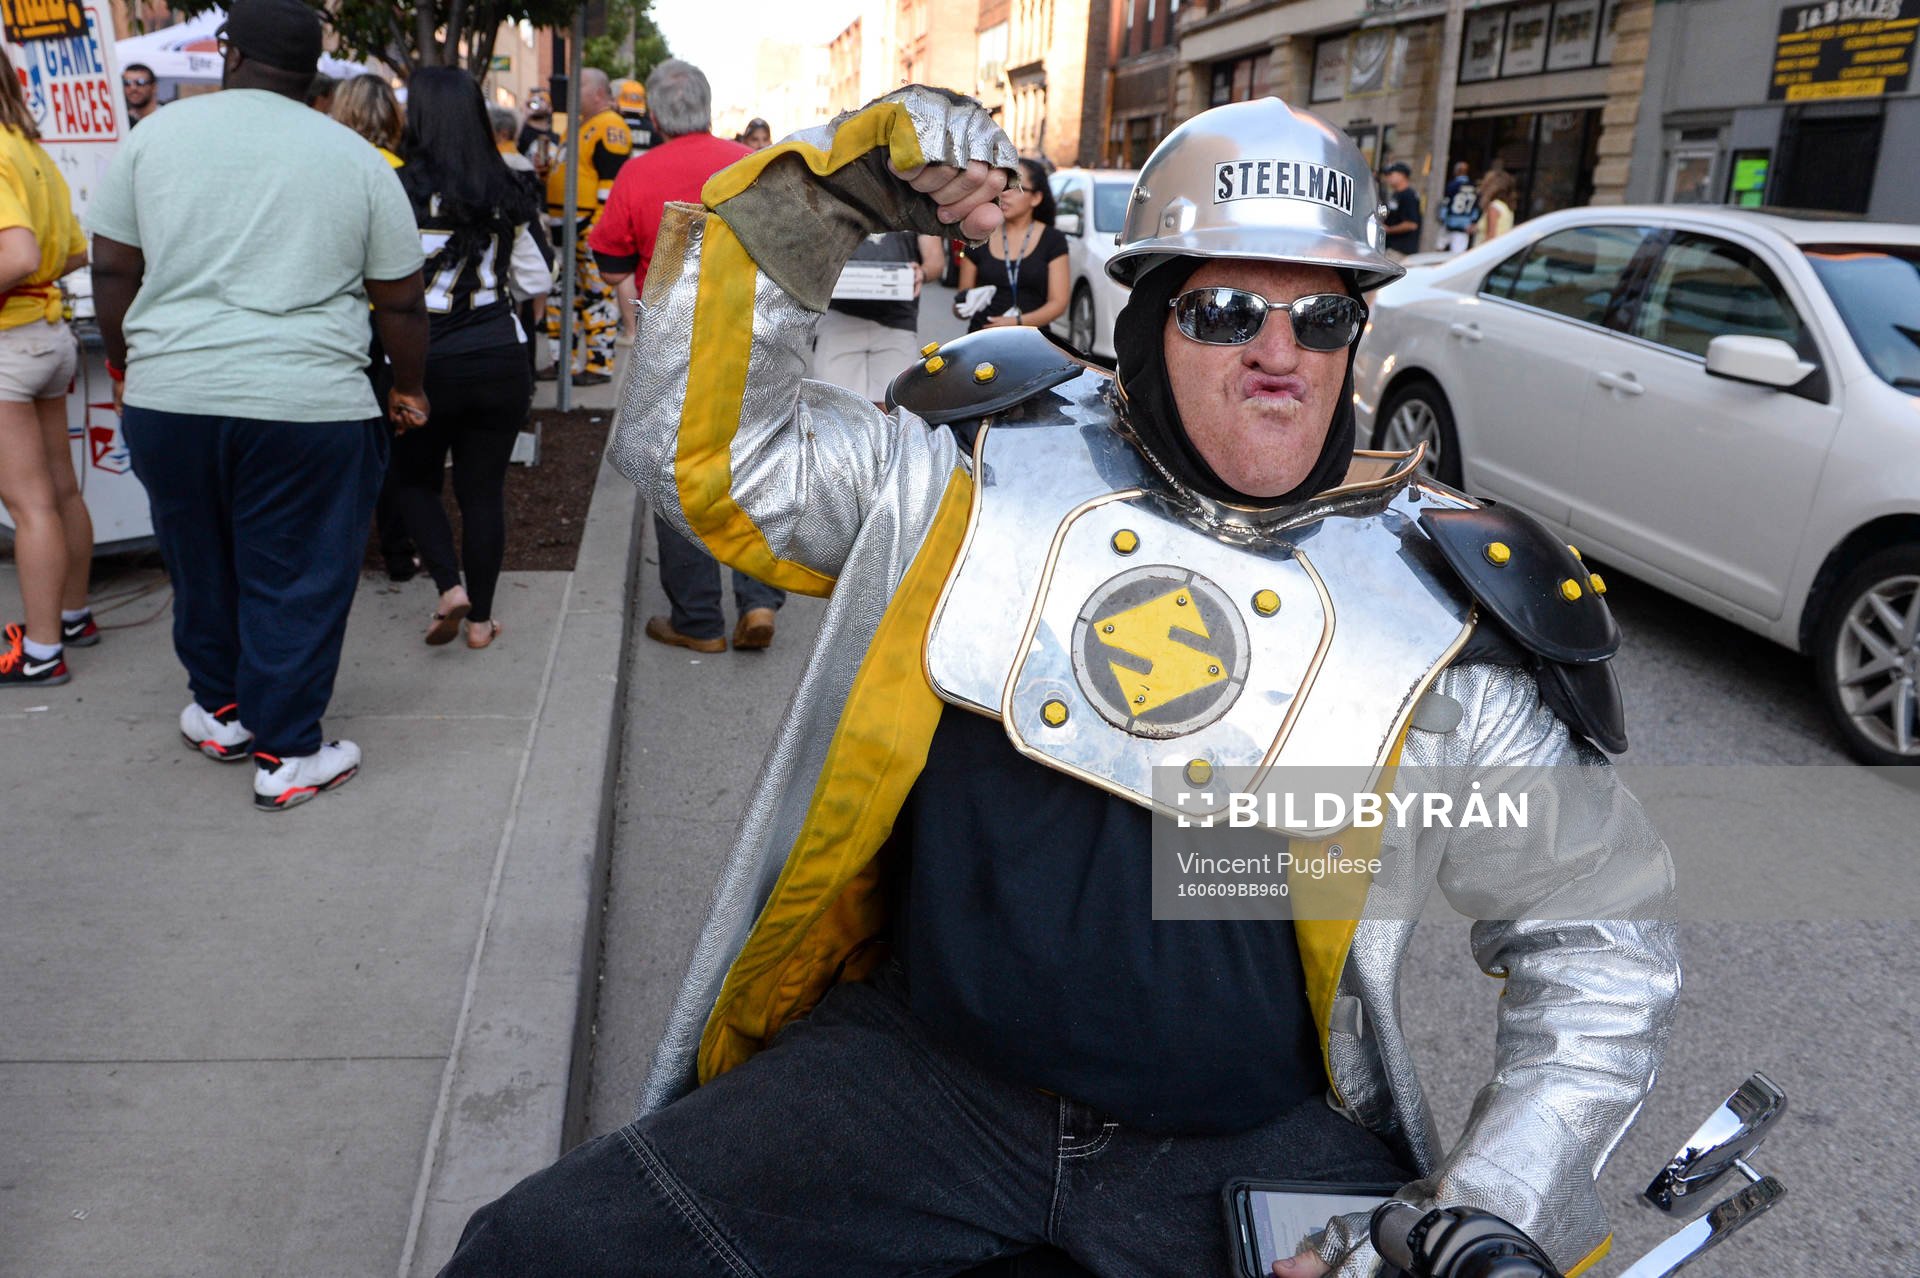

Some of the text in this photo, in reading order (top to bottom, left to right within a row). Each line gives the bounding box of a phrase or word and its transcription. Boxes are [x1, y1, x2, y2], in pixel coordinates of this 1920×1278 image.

[42, 18, 103, 77] GAME
[51, 80, 115, 134] FACES
[1218, 162, 1352, 211] STEELMAN
